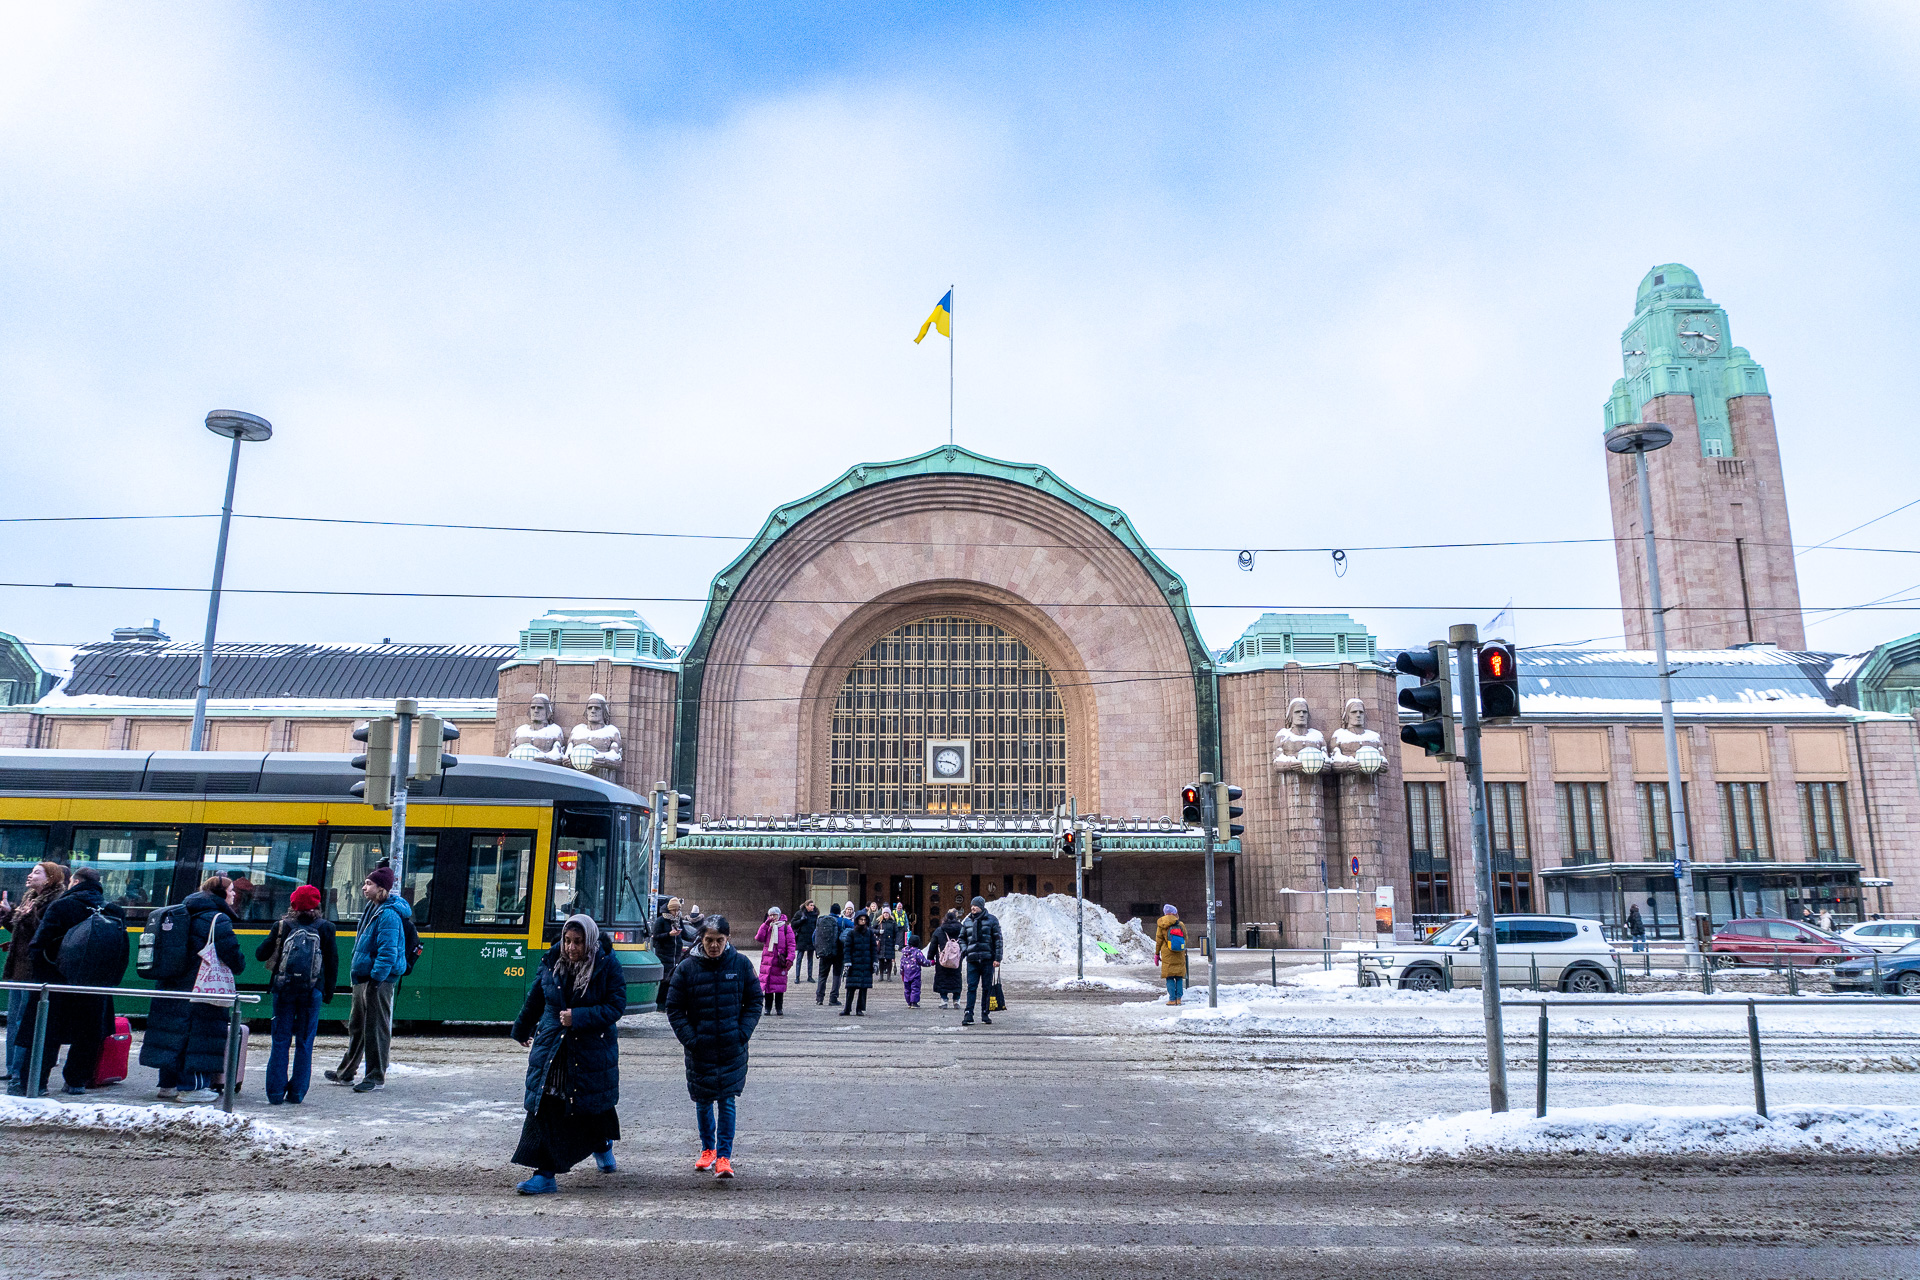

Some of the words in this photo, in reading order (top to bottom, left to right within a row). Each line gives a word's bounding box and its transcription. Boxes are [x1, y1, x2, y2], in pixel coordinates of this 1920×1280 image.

[700, 813, 913, 831] RAUTATIEASEMA
[940, 814, 1191, 832] JÄRNVÄGSTATION
[504, 966, 524, 976] 450
